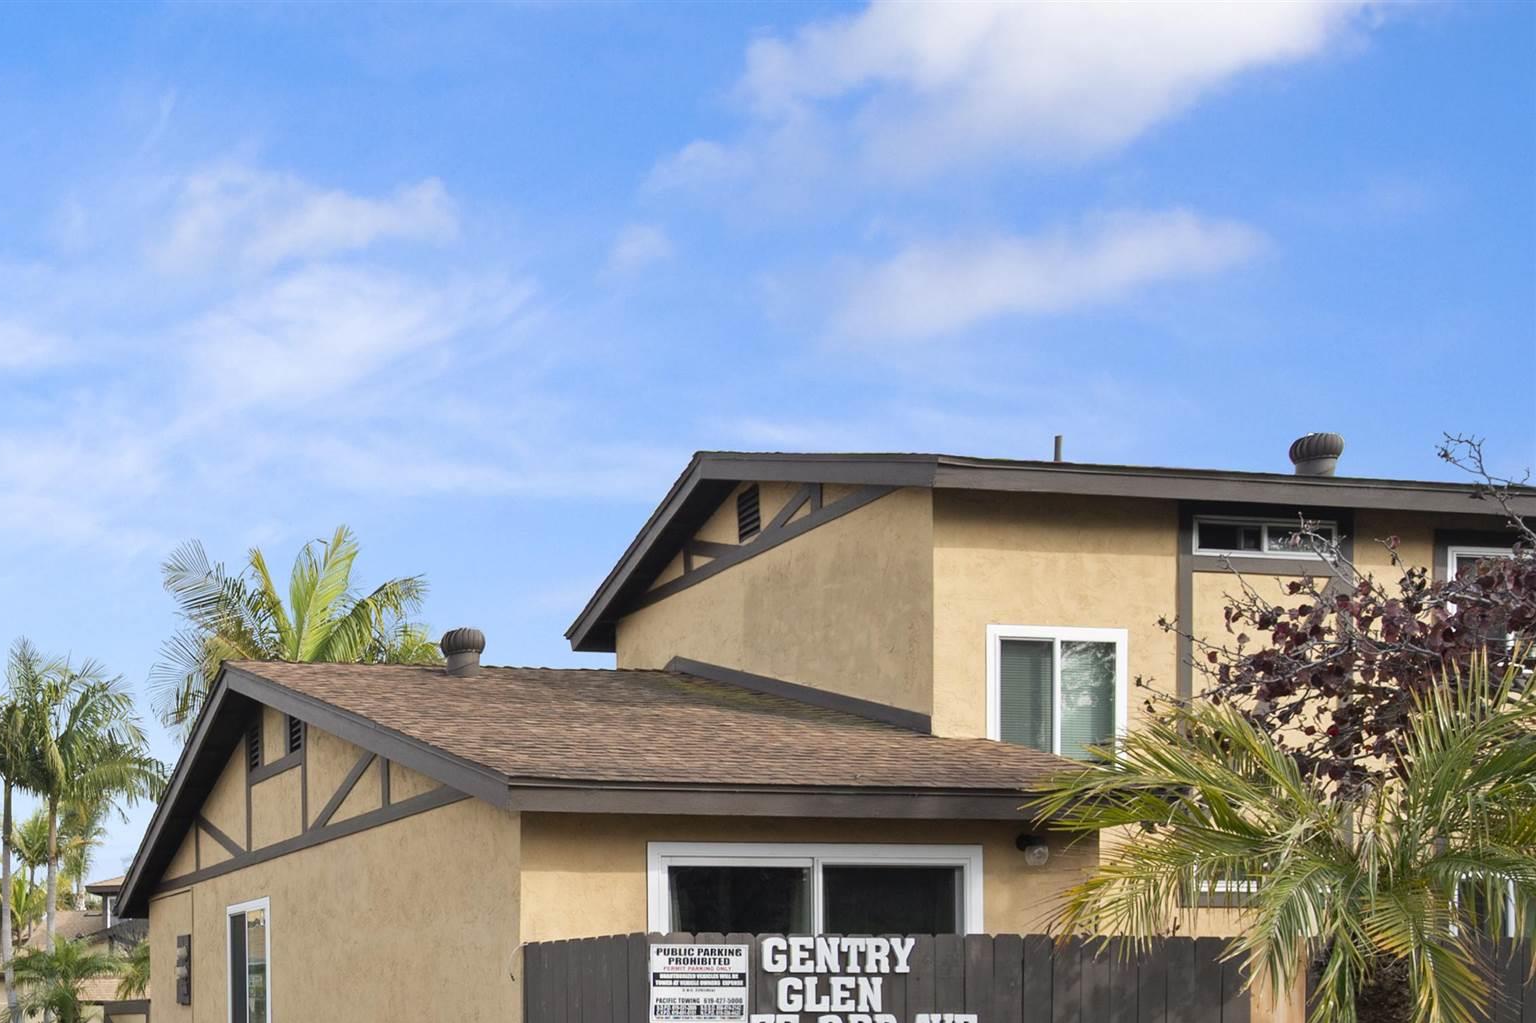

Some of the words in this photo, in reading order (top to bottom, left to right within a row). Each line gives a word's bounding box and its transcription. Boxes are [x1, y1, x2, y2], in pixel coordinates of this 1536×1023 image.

[656, 948, 695, 956] PUBLIC
[697, 948, 742, 956] PARKING
[668, 957, 730, 966] PROHIBITED
[761, 937, 915, 973] GENTRY
[777, 977, 883, 1012] GLEN
